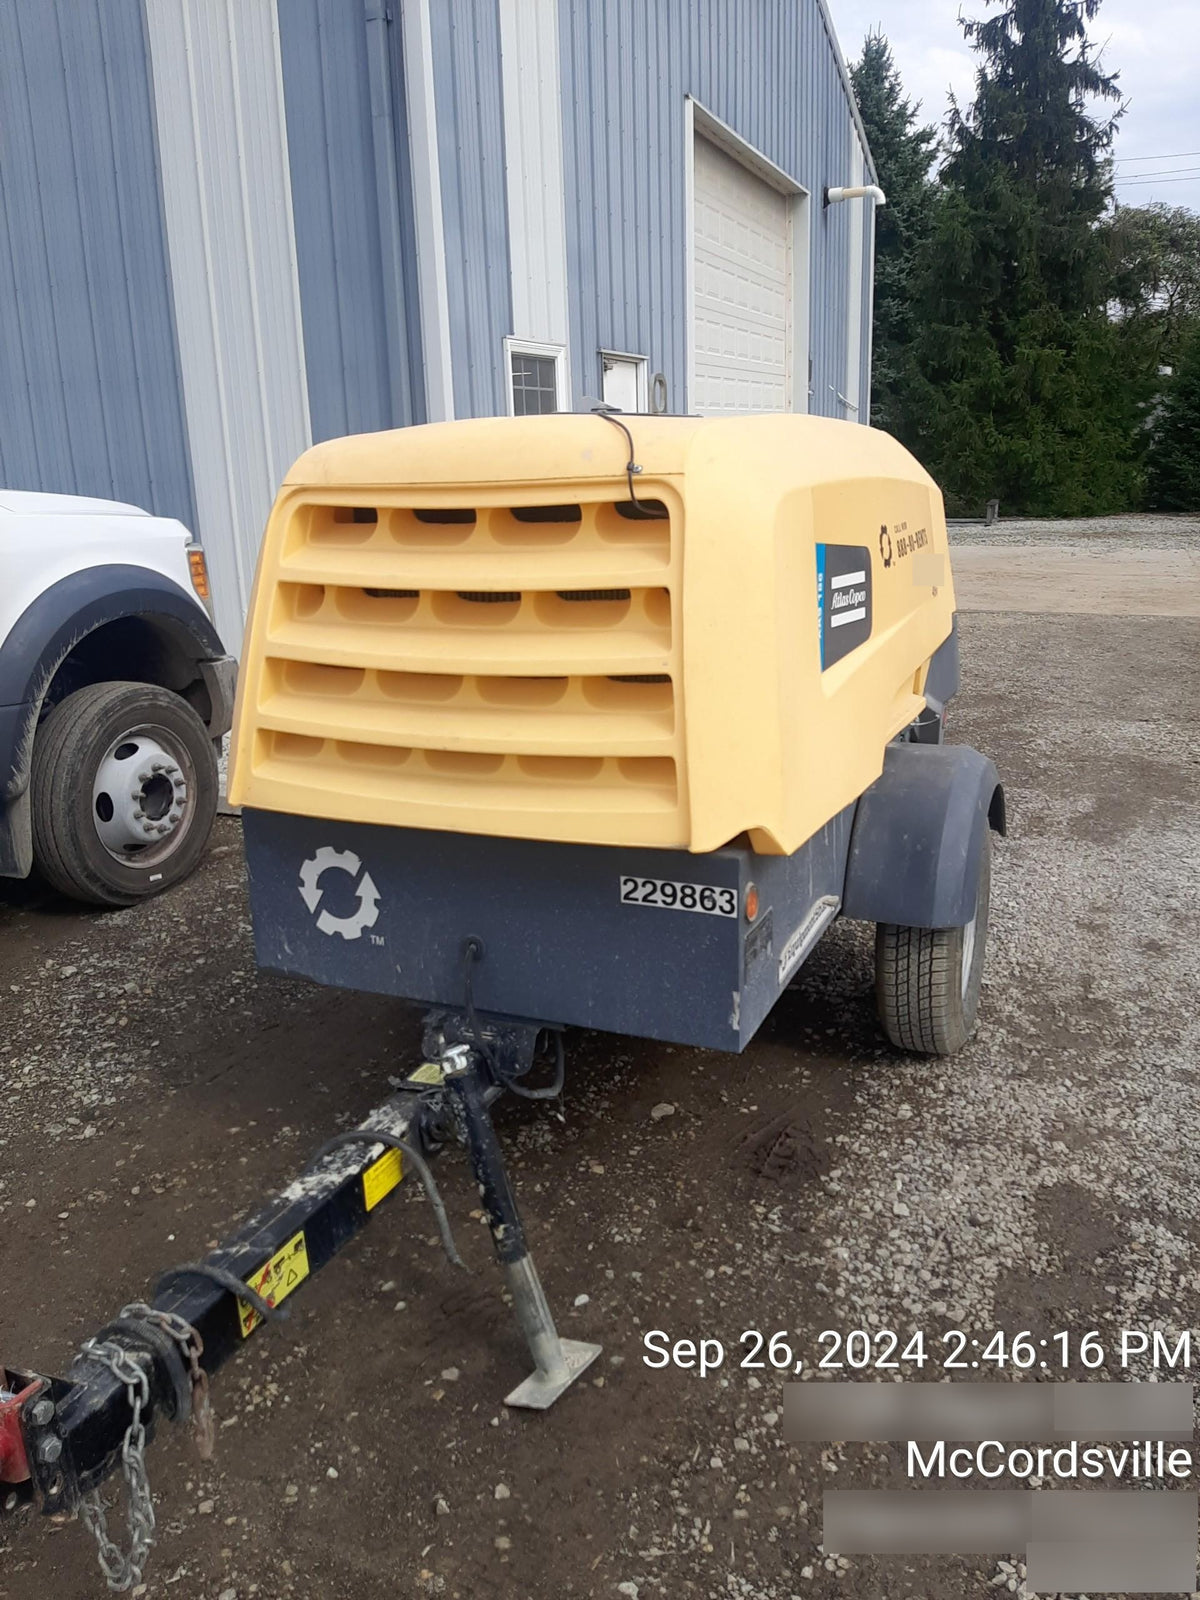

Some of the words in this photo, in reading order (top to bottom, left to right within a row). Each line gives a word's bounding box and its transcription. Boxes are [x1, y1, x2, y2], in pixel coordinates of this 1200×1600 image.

[831, 591, 849, 610] Atlas
[849, 588, 867, 607] Copco
[622, 878, 736, 915] 229863
[370, 935, 385, 946] TM
